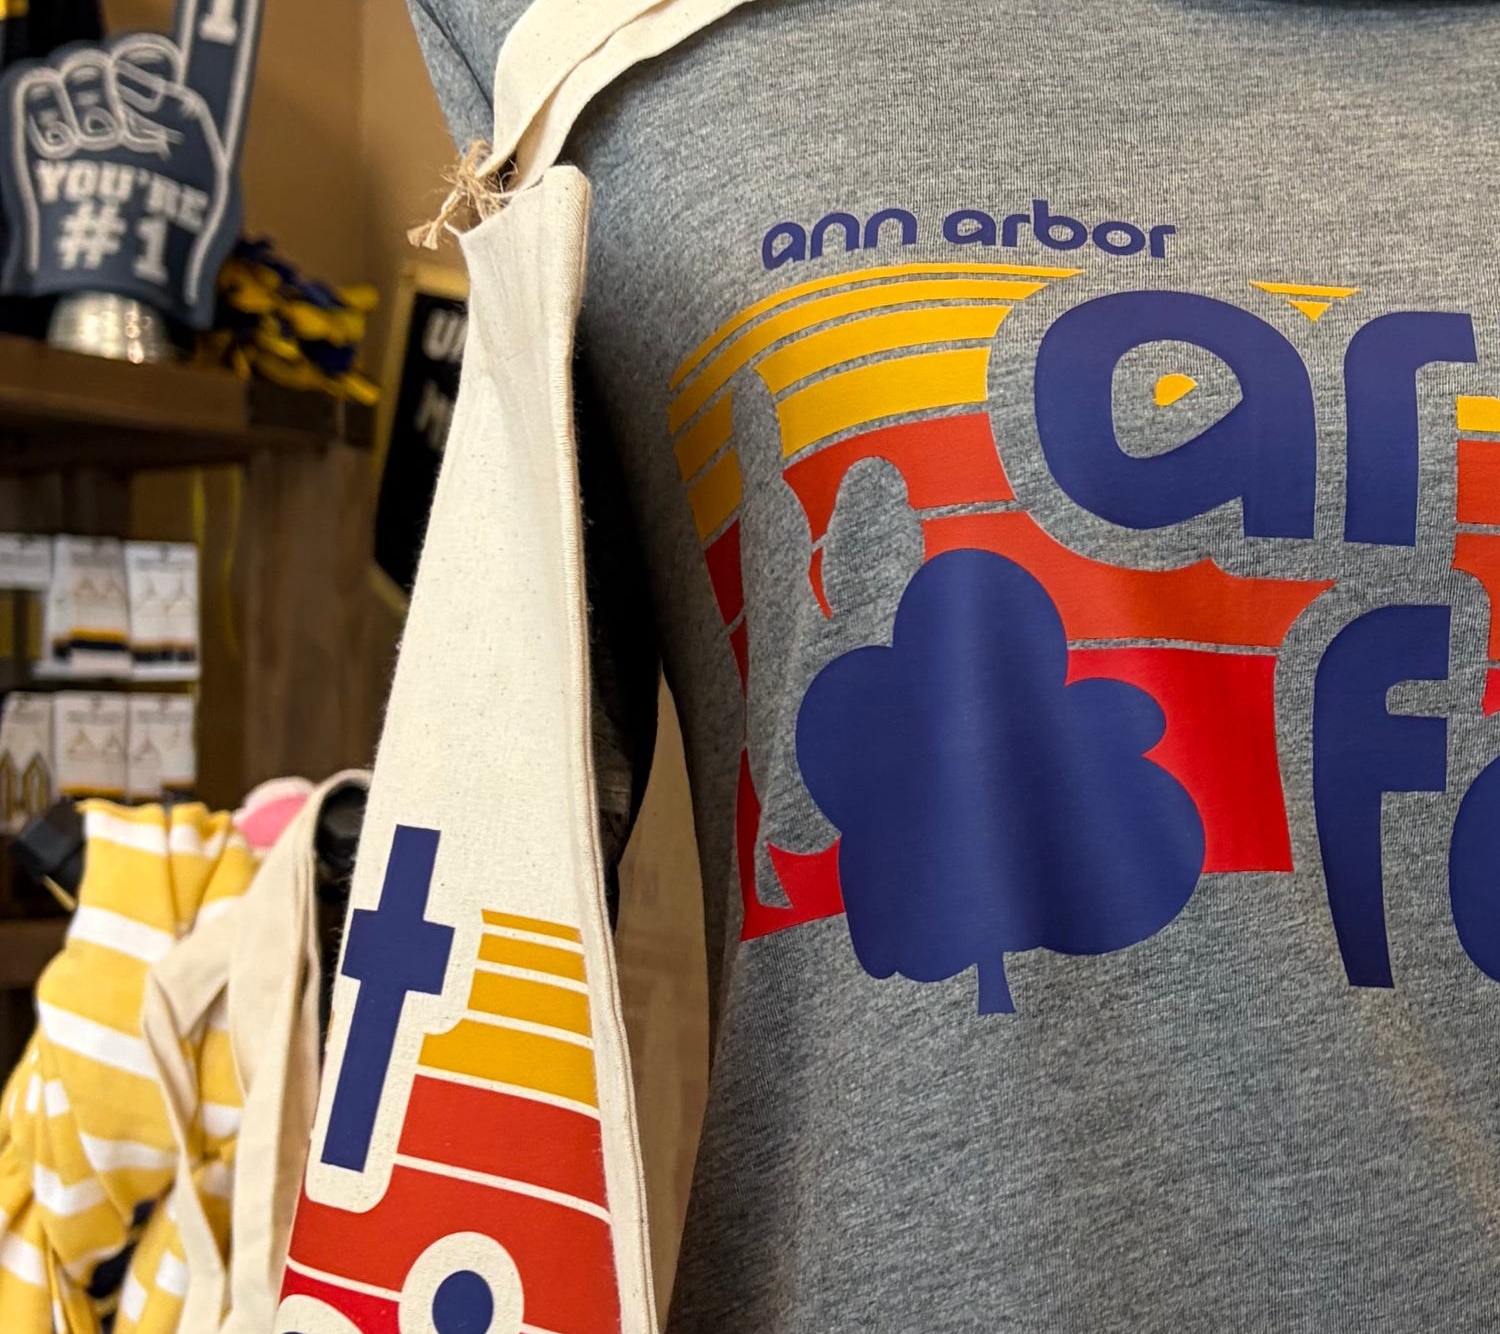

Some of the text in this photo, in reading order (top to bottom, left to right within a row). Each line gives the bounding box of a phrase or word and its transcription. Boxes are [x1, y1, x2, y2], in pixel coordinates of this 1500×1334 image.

[36, 159, 209, 235] YOU'RE
[762, 199, 1177, 270] ann arbor
[57, 200, 169, 284] #1
